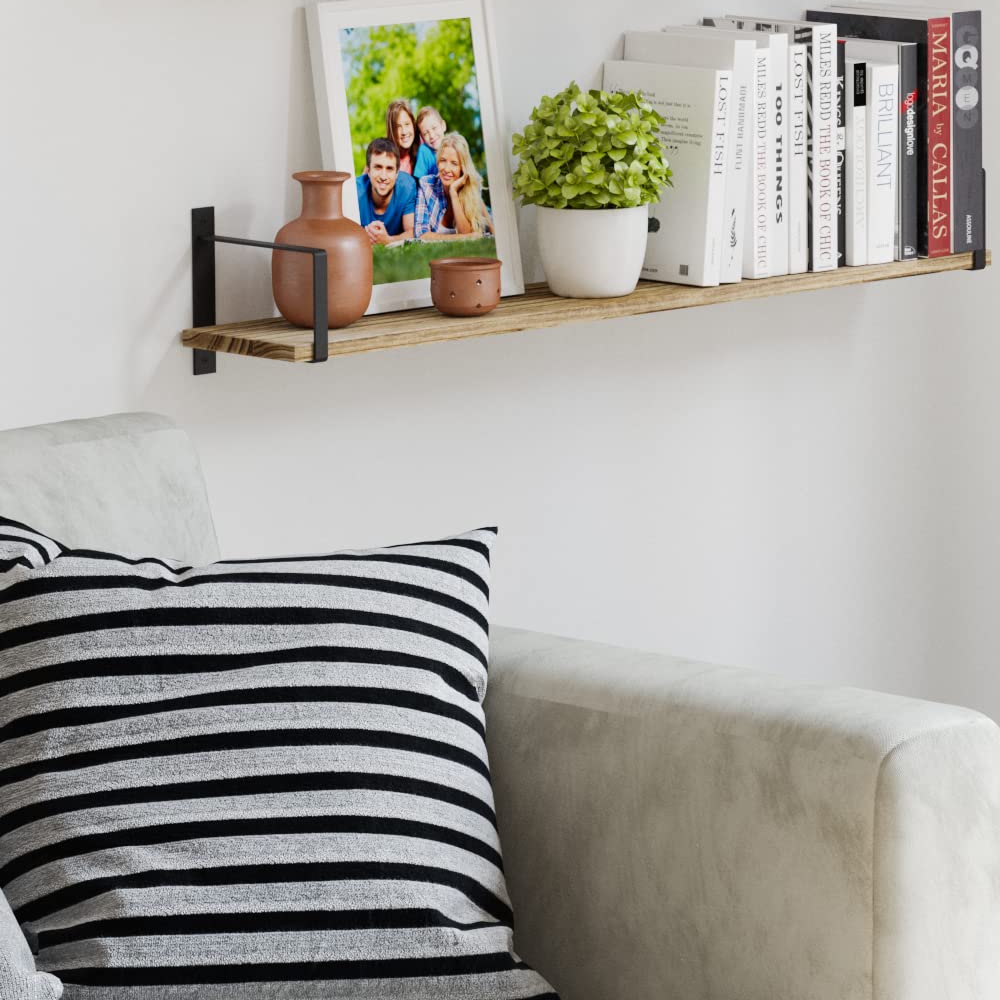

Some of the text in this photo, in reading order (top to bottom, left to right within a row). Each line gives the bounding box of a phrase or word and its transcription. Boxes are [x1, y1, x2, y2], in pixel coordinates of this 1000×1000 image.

[713, 77, 728, 174] LOST FISH
[794, 52, 804, 155] LOST FISH
[932, 31, 948, 117] MARIA
[757, 57, 767, 268] MILES REDD THE BOOK OF CHIC
[775, 83, 783, 224] 100 THINGS
[819, 32, 832, 261] MILES REDD THE BOOK OF CHIC
[876, 83, 894, 192] BRILLIANT
[933, 122, 945, 136] by
[932, 143, 948, 240] CALLAS
